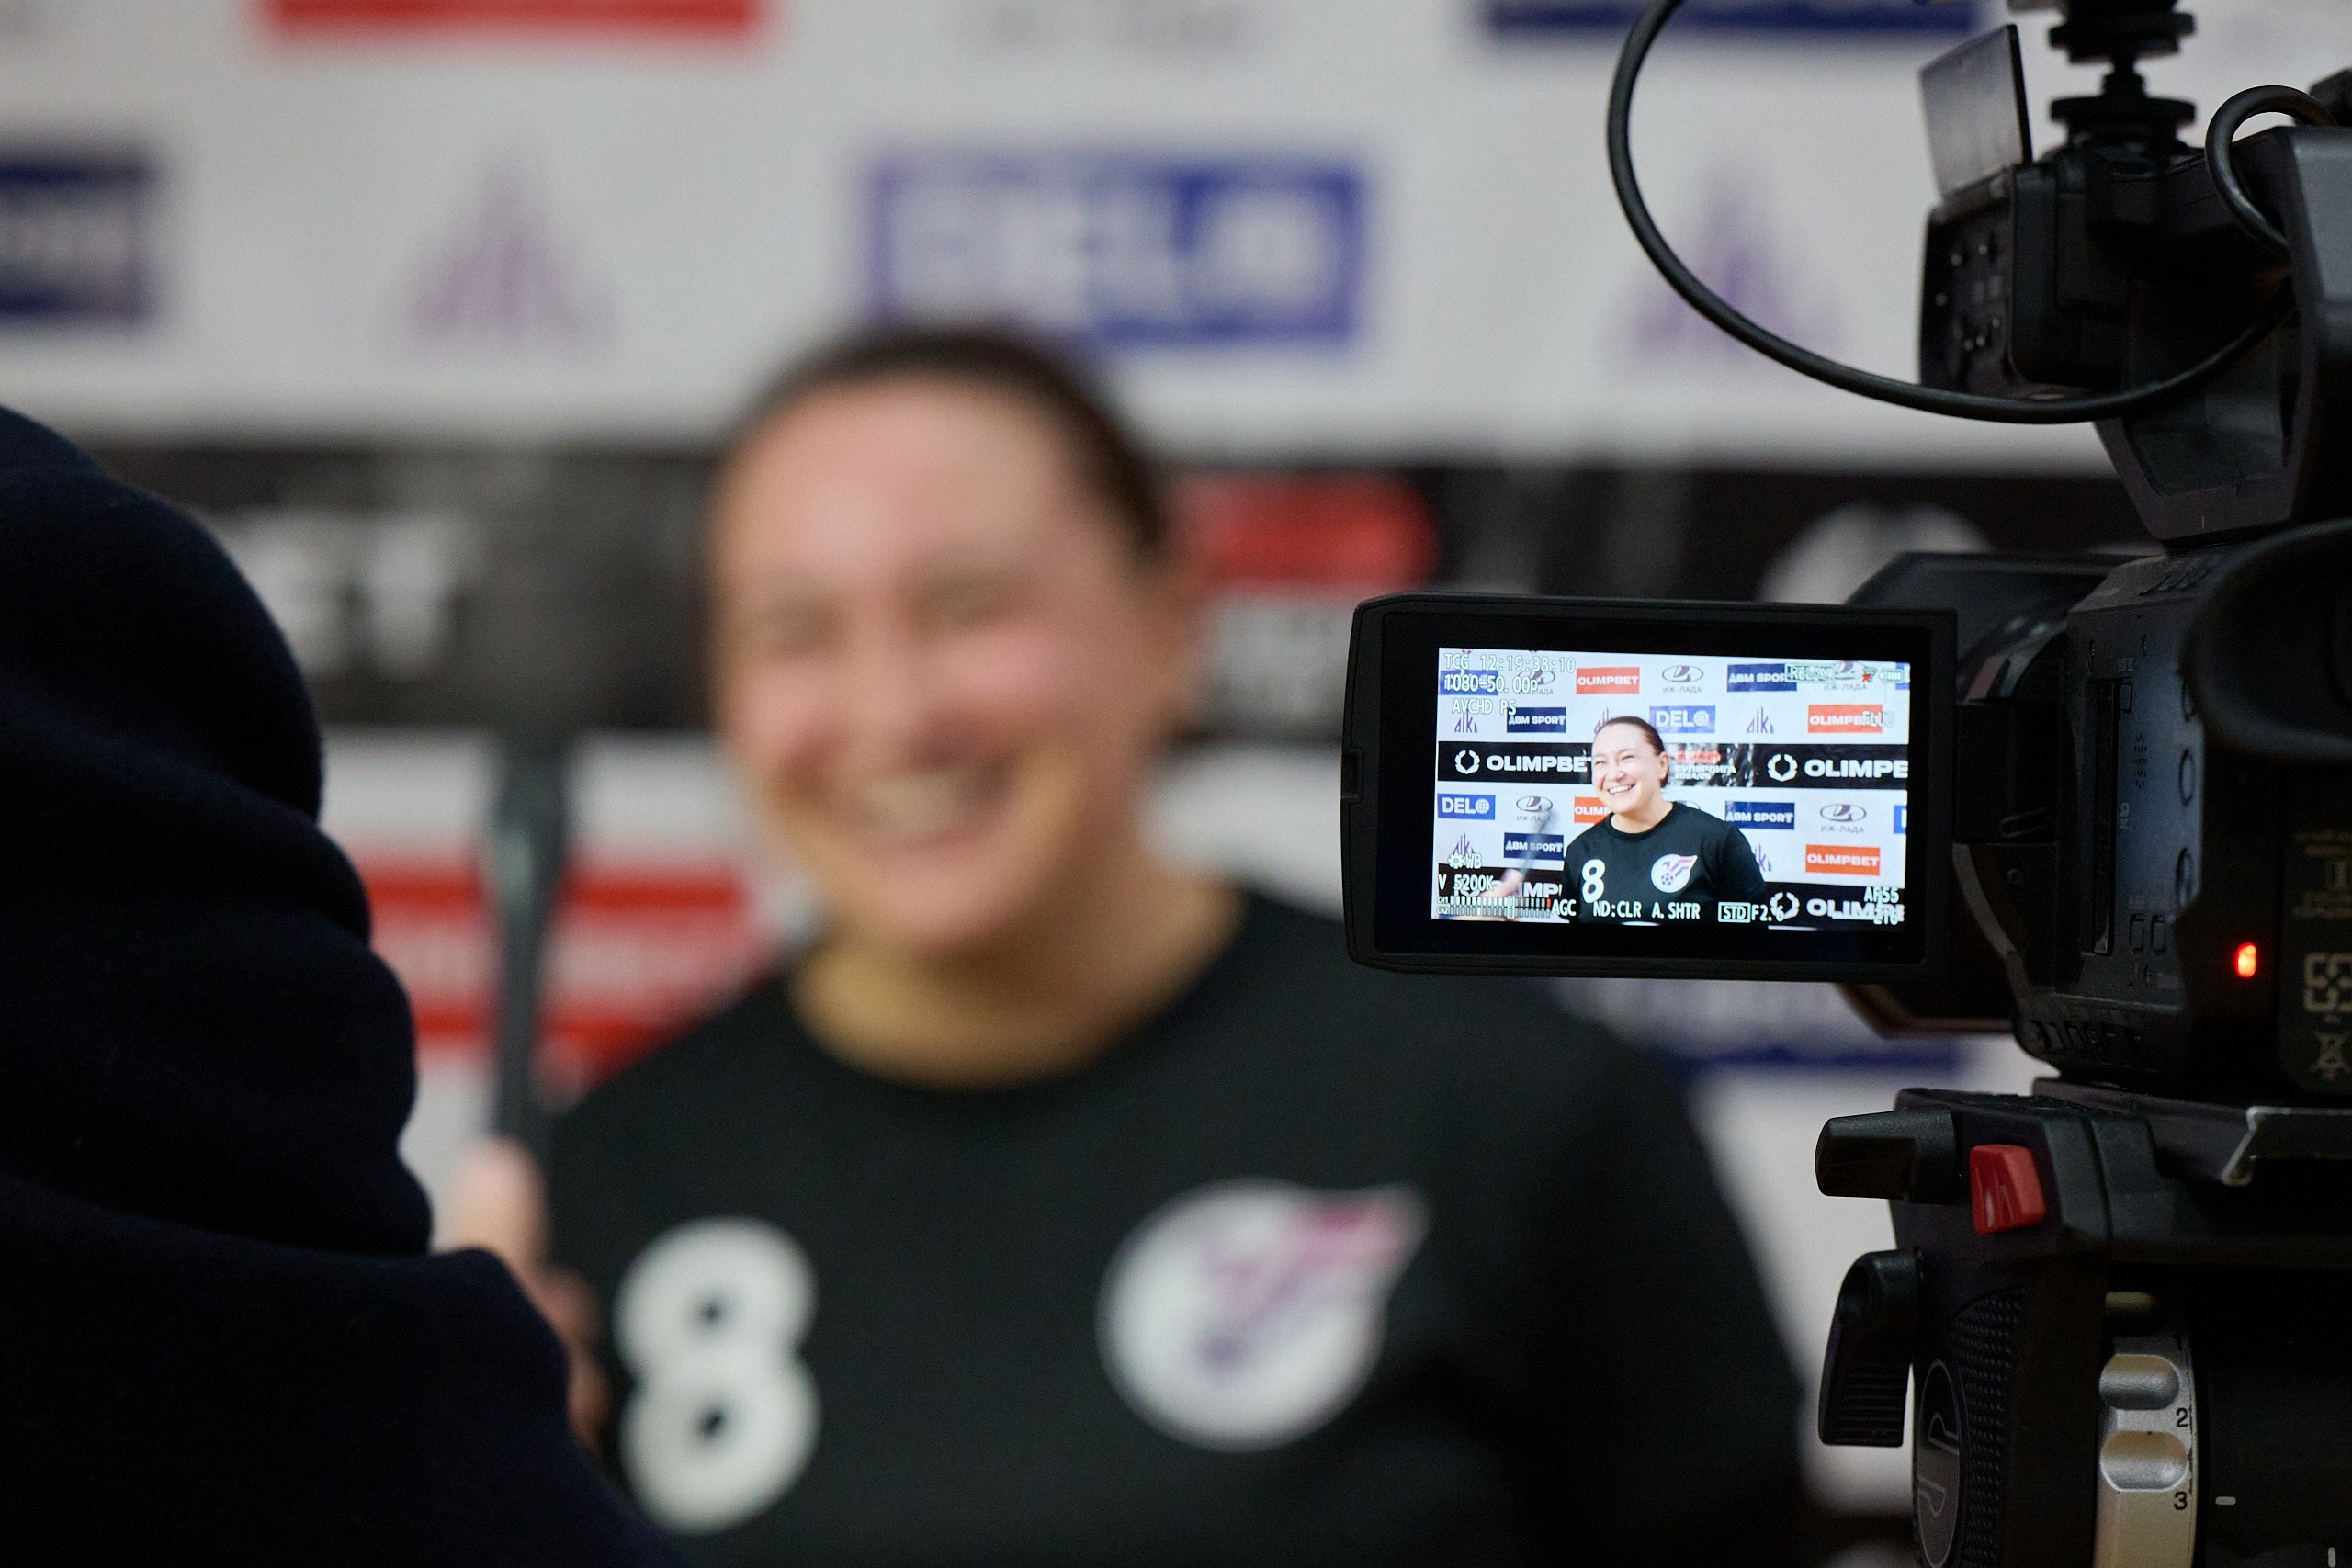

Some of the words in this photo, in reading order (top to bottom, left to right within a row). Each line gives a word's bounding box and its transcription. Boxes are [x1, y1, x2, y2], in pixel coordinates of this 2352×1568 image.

[1443, 653, 1470, 671] TCG
[1479, 655, 1577, 673] 12:19:38:10
[1577, 676, 1639, 686] OLIMPBET
[1452, 698, 1493, 716] AVCHD
[1499, 699, 1516, 716] PS
[1531, 716, 1566, 726] SPORT
[1753, 812, 1794, 824] SPORT
[1504, 840, 1528, 851] ABM
[1529, 842, 1564, 853] SPORT
[1806, 853, 1881, 867] OLIMPBET
[1453, 874, 1495, 892] 5200K
[1581, 859, 1606, 904] 8
[1551, 899, 1577, 917] AGC
[1592, 900, 1643, 919] ND:CLR
[1723, 905, 1747, 920] STD
[613, 1214, 820, 1532] 8
[2176, 1407, 2188, 1427] 2
[2174, 1491, 2188, 1510] 3
